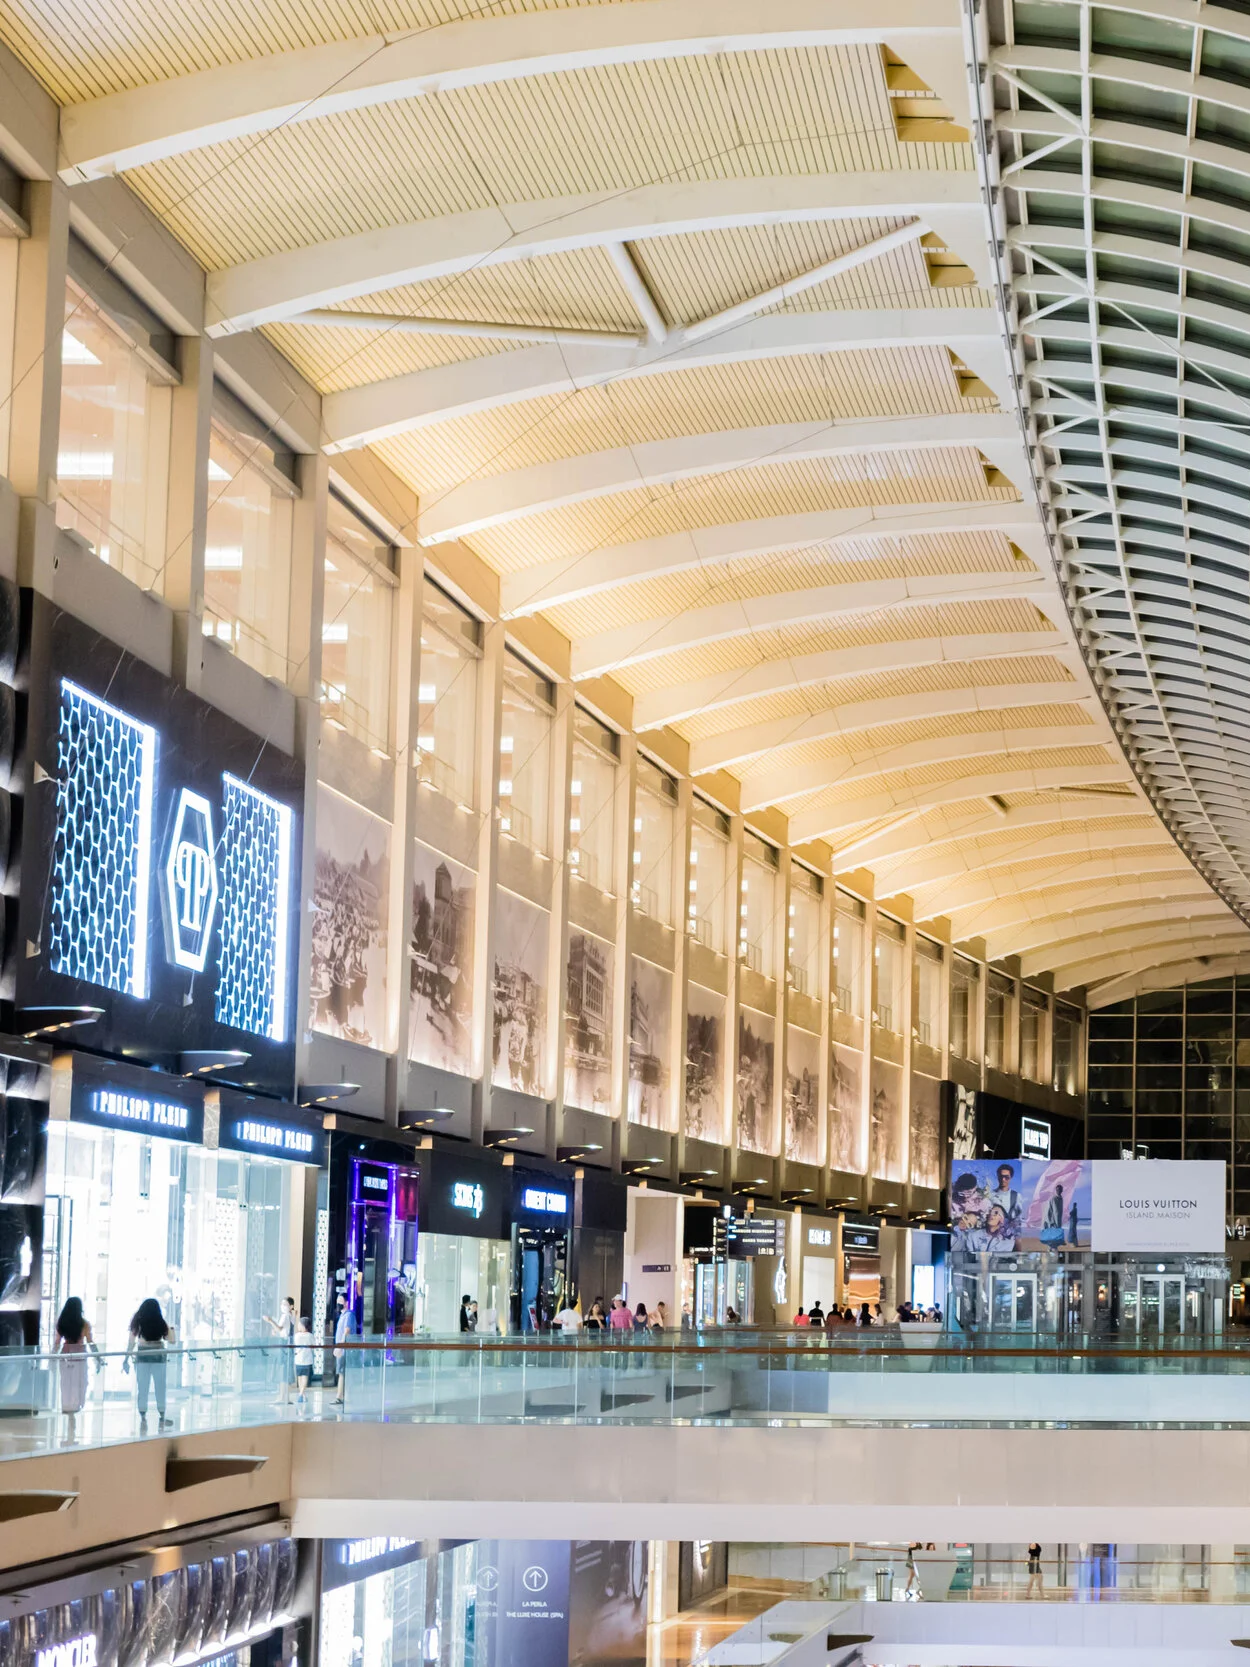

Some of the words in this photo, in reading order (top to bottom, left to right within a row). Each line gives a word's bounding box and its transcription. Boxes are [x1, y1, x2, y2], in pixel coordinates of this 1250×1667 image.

[100, 1091, 150, 1121] PHILIPP
[153, 1102, 188, 1128] PLEIN
[243, 1121, 282, 1146] PHILIPP
[285, 1130, 313, 1152] PLEIN
[1119, 1199, 1150, 1209] LOUIS
[1153, 1199, 1197, 1209] VUITTON
[1126, 1211, 1154, 1219] ISLAND
[1156, 1211, 1191, 1219] MAISON
